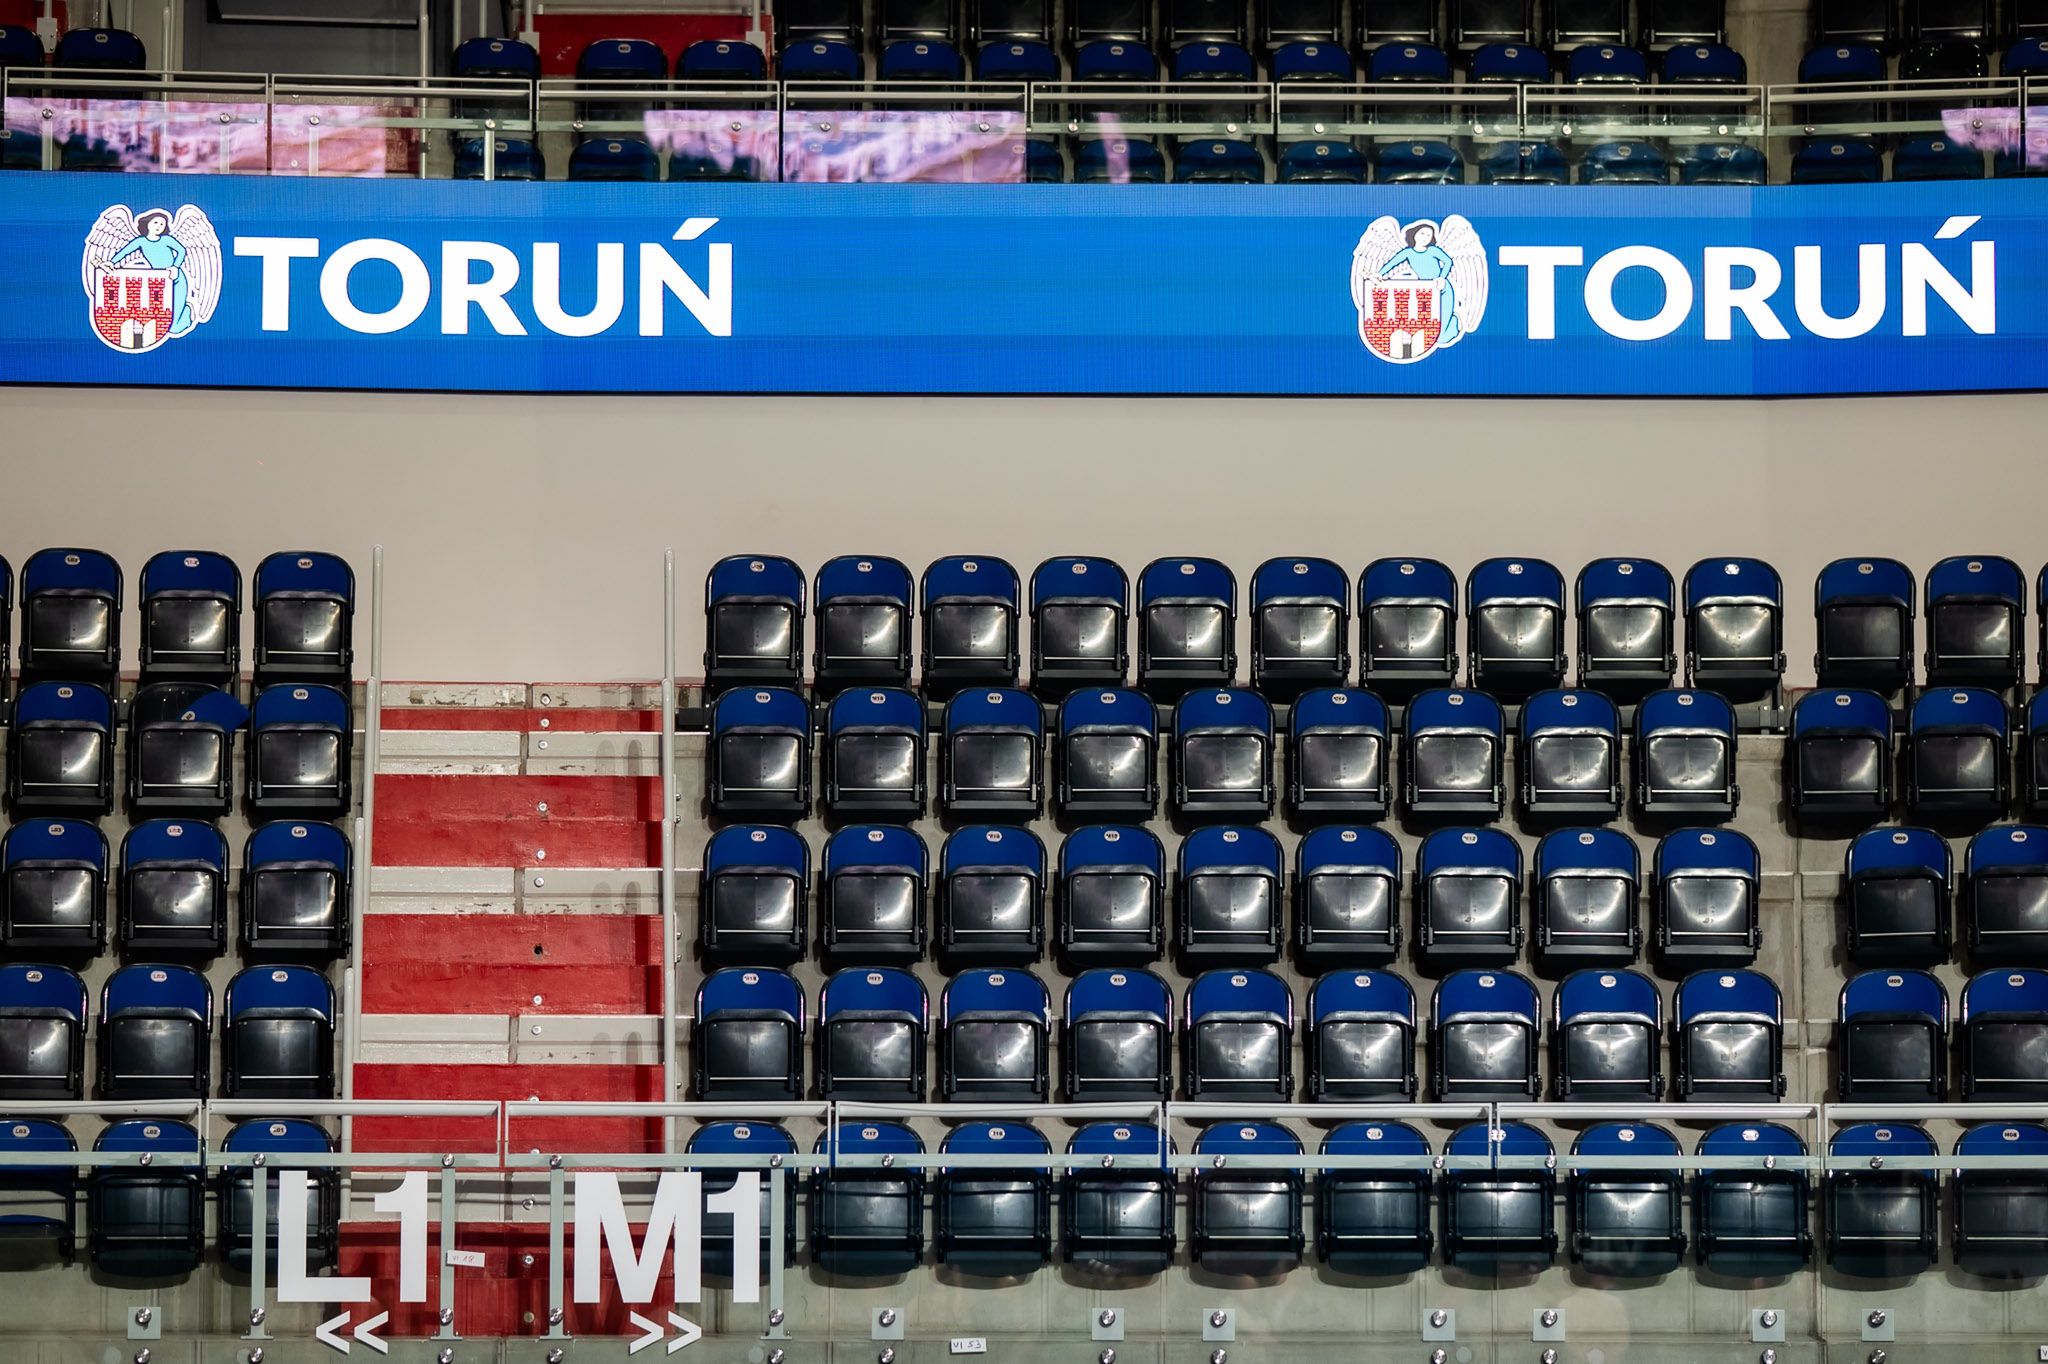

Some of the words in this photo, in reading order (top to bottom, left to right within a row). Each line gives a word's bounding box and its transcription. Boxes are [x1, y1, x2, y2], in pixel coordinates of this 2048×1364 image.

[235, 218, 732, 336] TORUŃ
[1500, 216, 1995, 340] TORUŃ
[278, 1171, 428, 1302] L1
[574, 1171, 761, 1303] M1
